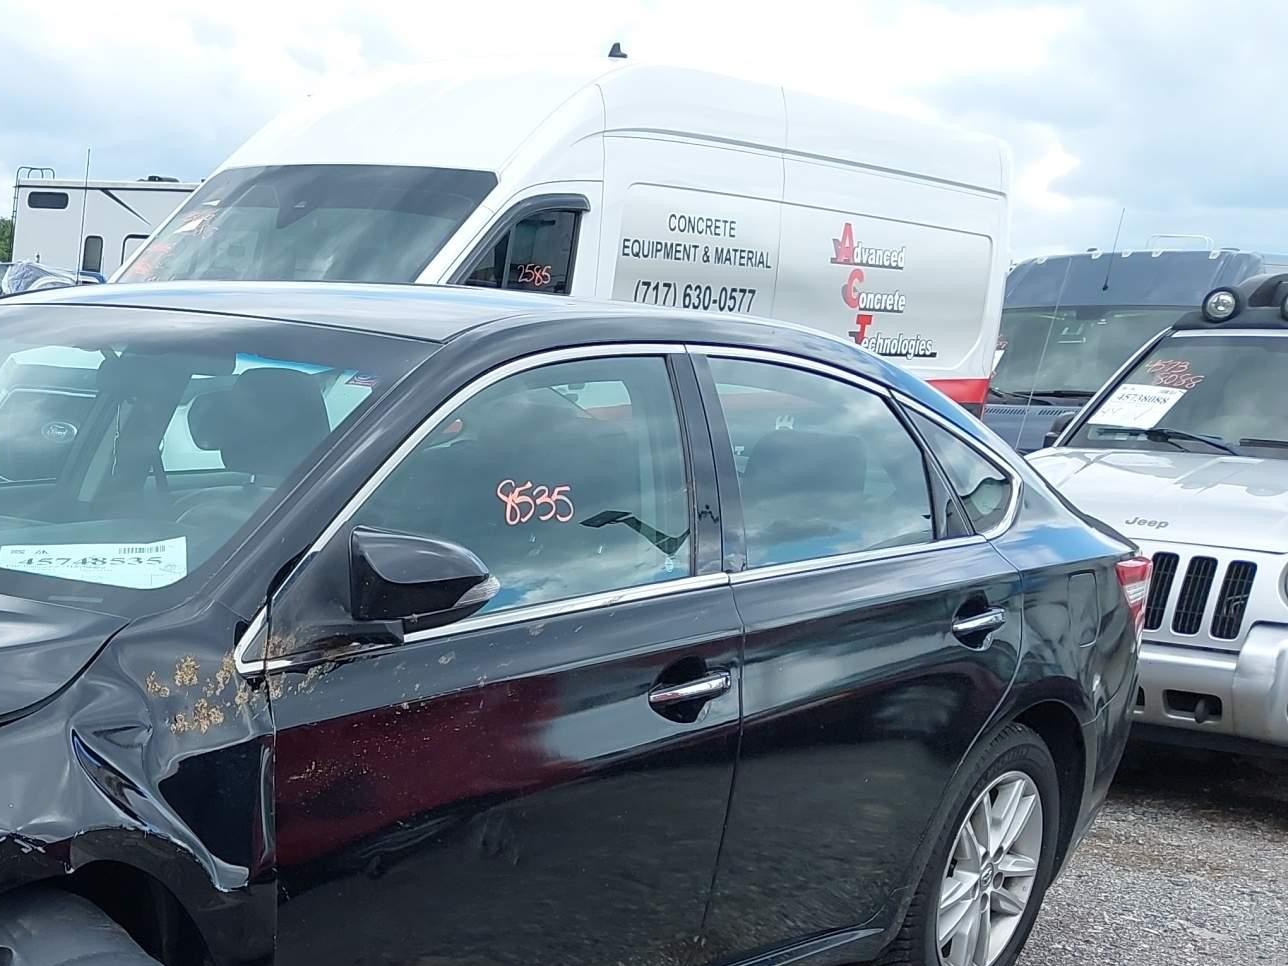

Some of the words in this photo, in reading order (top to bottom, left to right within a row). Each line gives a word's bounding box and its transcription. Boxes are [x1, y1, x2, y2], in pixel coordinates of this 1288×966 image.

[668, 213, 737, 238] CONCRETE
[621, 238, 700, 263] EQUIPMENT
[701, 245, 711, 264] &
[713, 246, 772, 269] MATERIAL
[836, 222, 905, 268] Advanced
[517, 263, 552, 286] 2585
[843, 268, 906, 310] Concrete
[633, 279, 677, 307] (717)
[682, 283, 757, 313] 630-0577
[853, 313, 933, 360] Technologies
[497, 479, 574, 525] 8535
[1125, 517, 1169, 529] Jeep
[18, 556, 163, 566] 45748535
